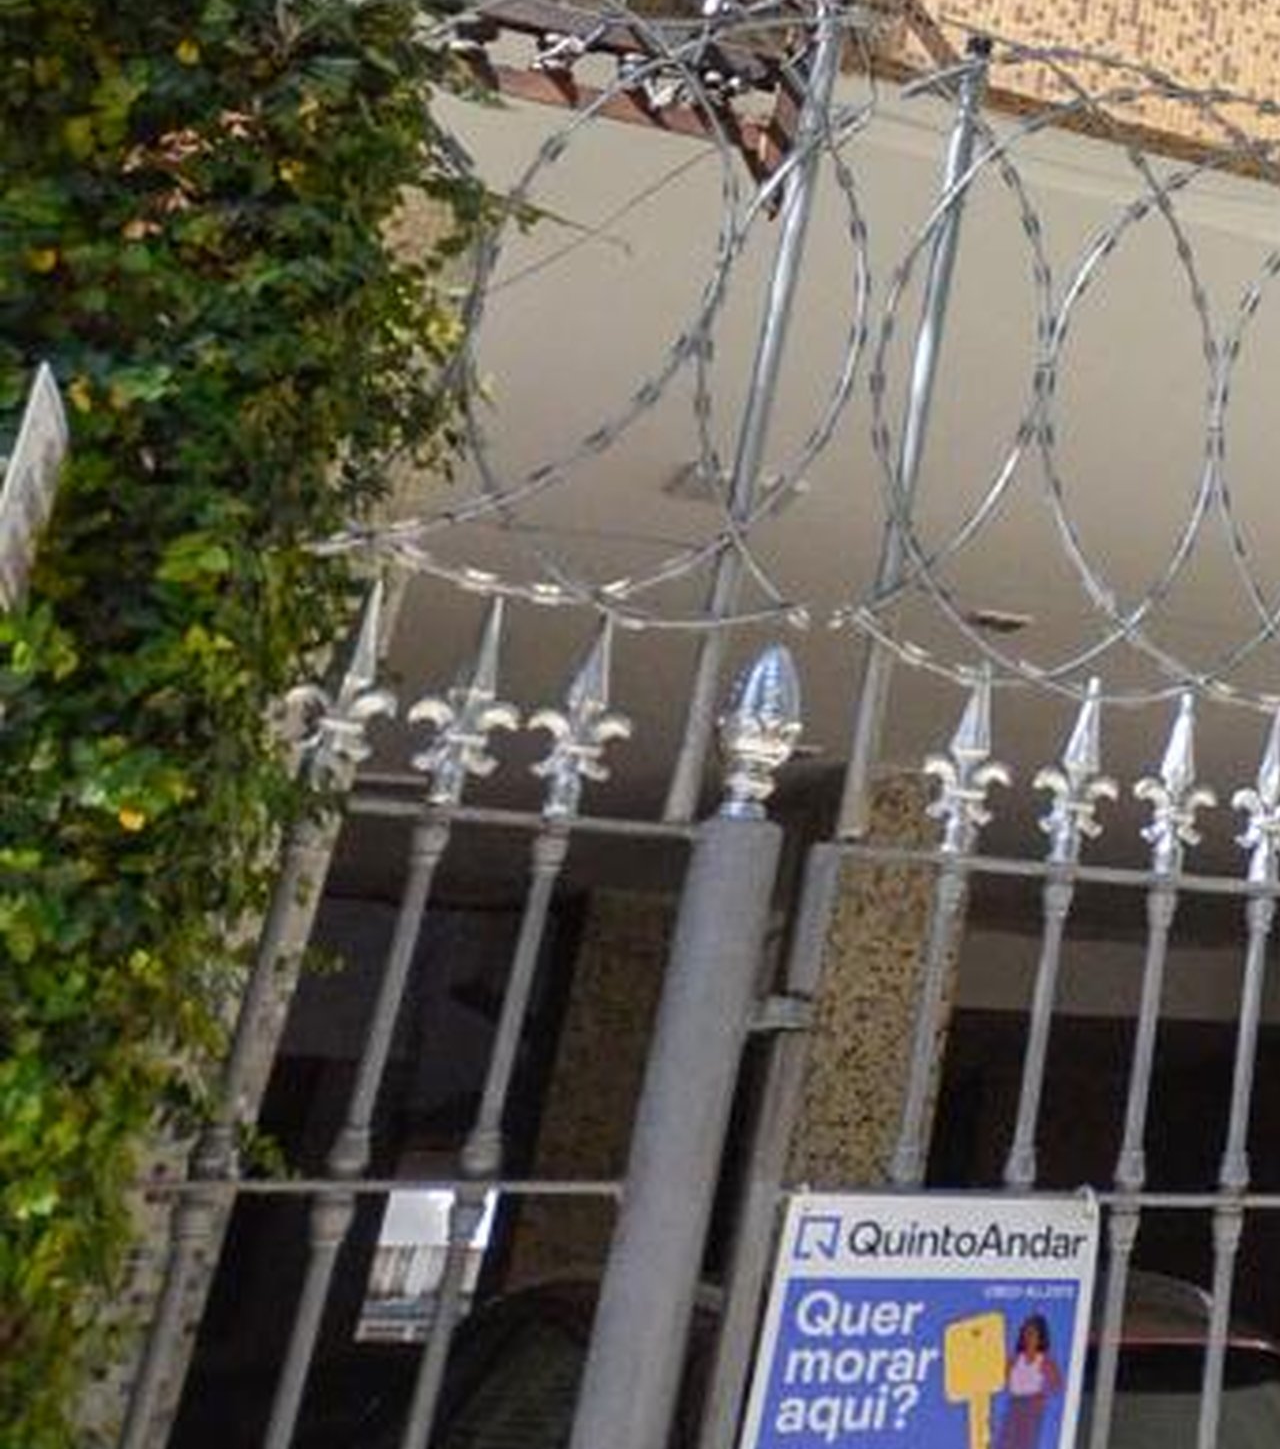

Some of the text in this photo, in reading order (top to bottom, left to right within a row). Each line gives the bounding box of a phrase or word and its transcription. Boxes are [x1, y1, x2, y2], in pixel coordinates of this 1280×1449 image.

[847, 1220, 1089, 1262] QuintoAndar
[797, 1289, 924, 1338] Quer
[782, 1341, 940, 1385] morar
[774, 1383, 920, 1443] aqui?
